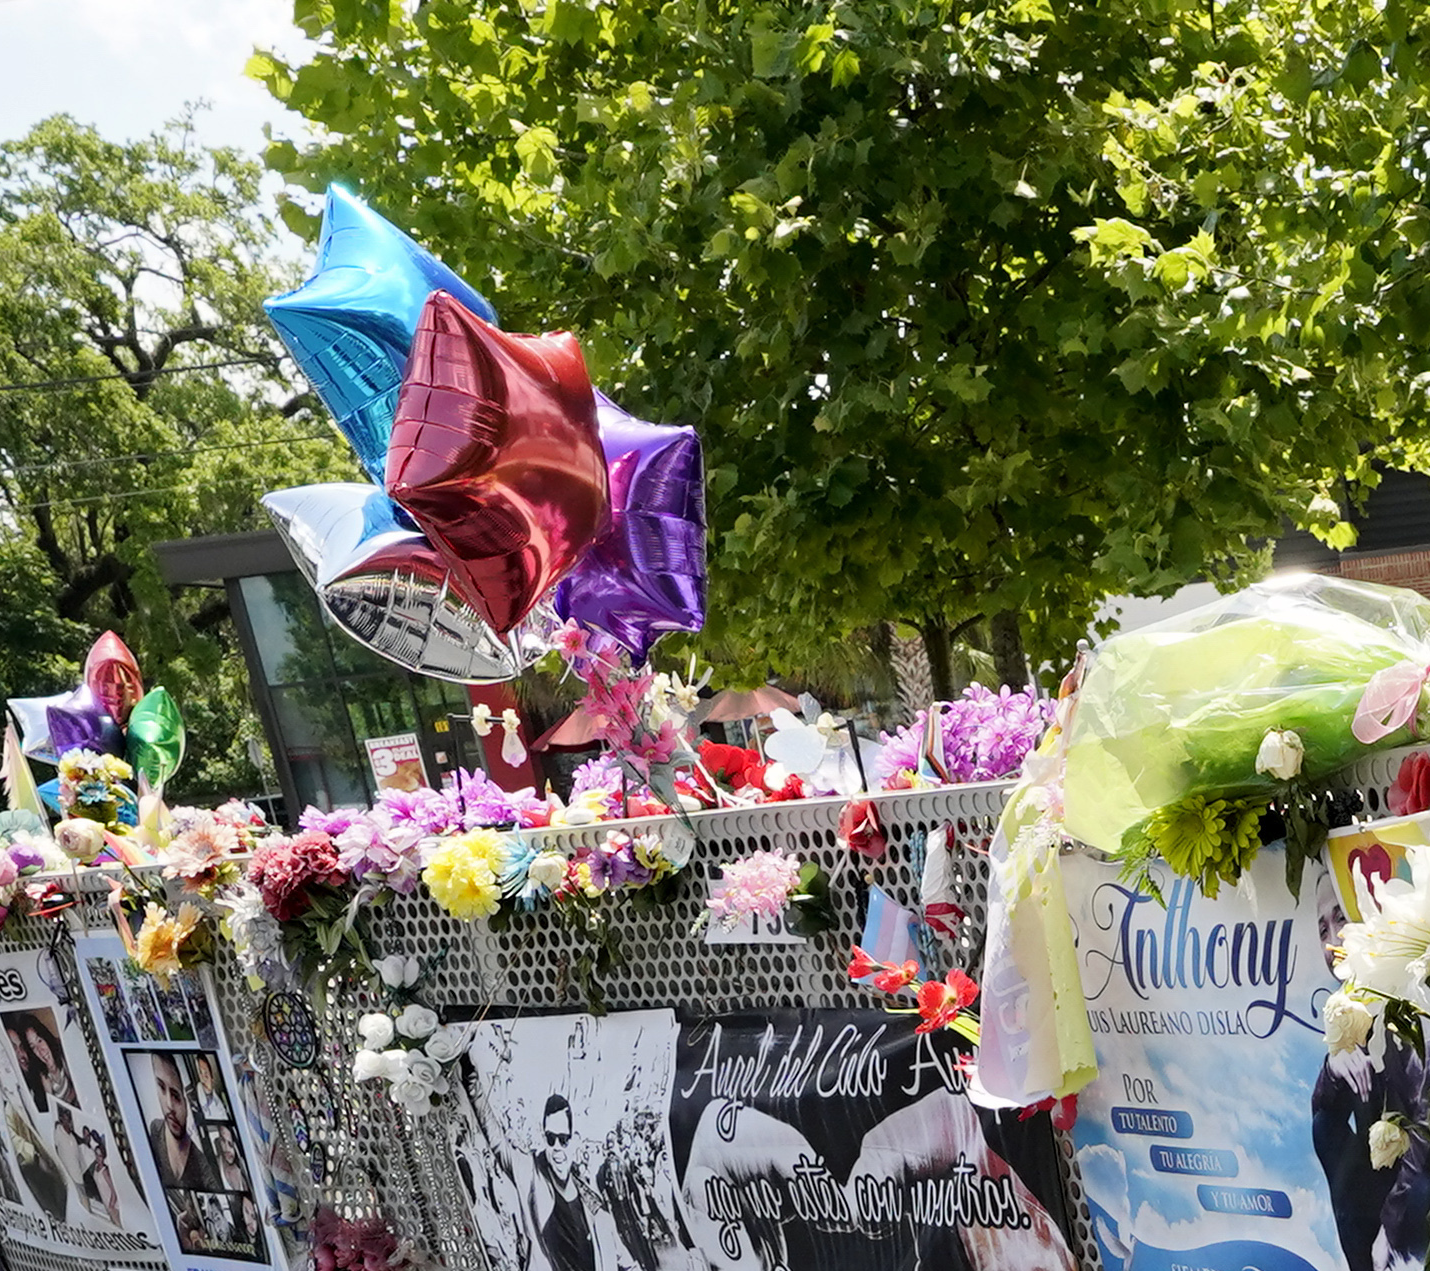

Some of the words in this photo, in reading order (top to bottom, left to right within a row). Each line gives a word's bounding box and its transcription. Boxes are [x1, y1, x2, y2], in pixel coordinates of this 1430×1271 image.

[1085, 879, 1327, 1039] Anthony
[1088, 1009, 1111, 1033] UIS
[1115, 1008, 1192, 1035] LAUREANO
[1199, 1010, 1247, 1036] DISLA
[681, 1022, 774, 1142] Angel
[770, 1024, 823, 1098] del
[1122, 1072, 1157, 1104] POR
[1118, 1112, 1136, 1129] TU
[1135, 1113, 1177, 1134] TALENTO
[1159, 1151, 1176, 1168] TU
[704, 1174, 742, 1260] ya
[744, 1176, 782, 1220] no
[854, 1174, 902, 1224] con
[1212, 1193, 1220, 1207] Y
[1222, 1194, 1237, 1208] TU
[1239, 1195, 1273, 1213] AMOR
